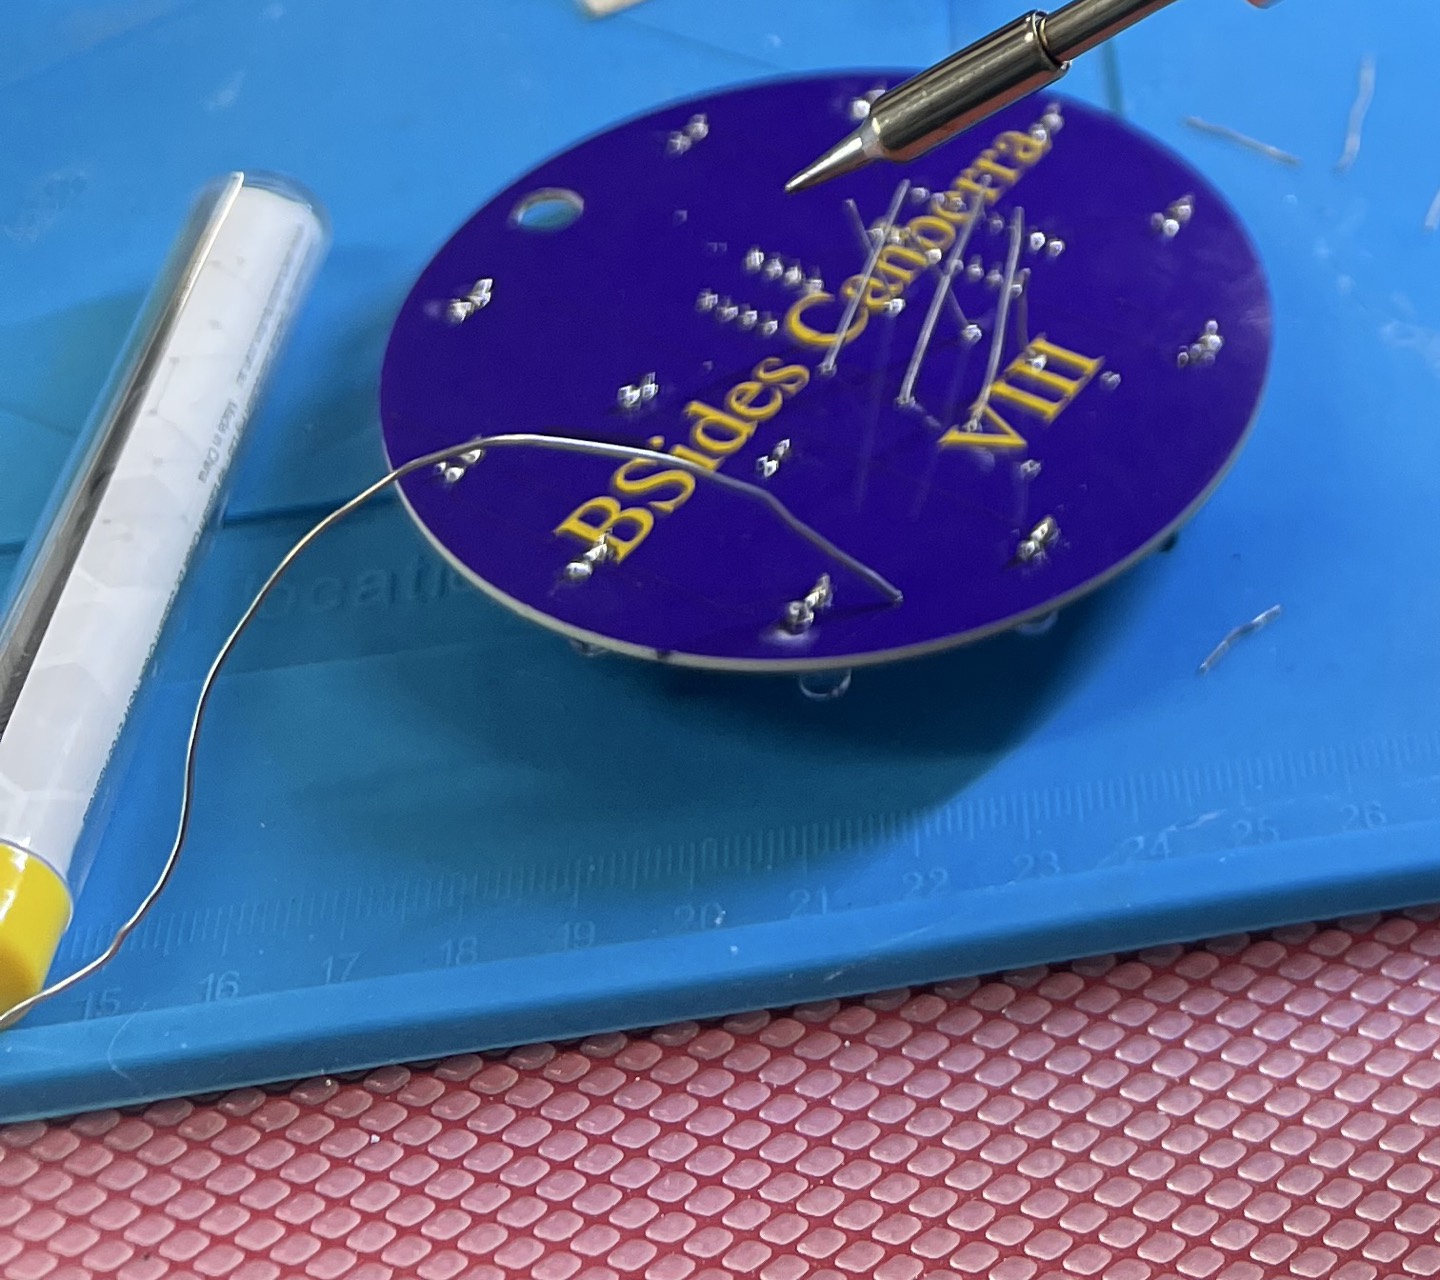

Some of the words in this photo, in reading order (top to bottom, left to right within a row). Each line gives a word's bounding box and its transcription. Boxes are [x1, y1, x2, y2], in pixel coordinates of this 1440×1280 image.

[552, 356, 810, 565] BSides
[938, 332, 1105, 450] VIII
[200, 968, 242, 1003] 16
[321, 951, 363, 985] 17
[440, 935, 480, 967] 18
[560, 918, 598, 952] 19
[789, 887, 832, 920] 21
[902, 868, 949, 899] 22
[1012, 850, 1061, 881] 23
[1231, 816, 1279, 846] 25
[1340, 800, 1389, 831] 26
